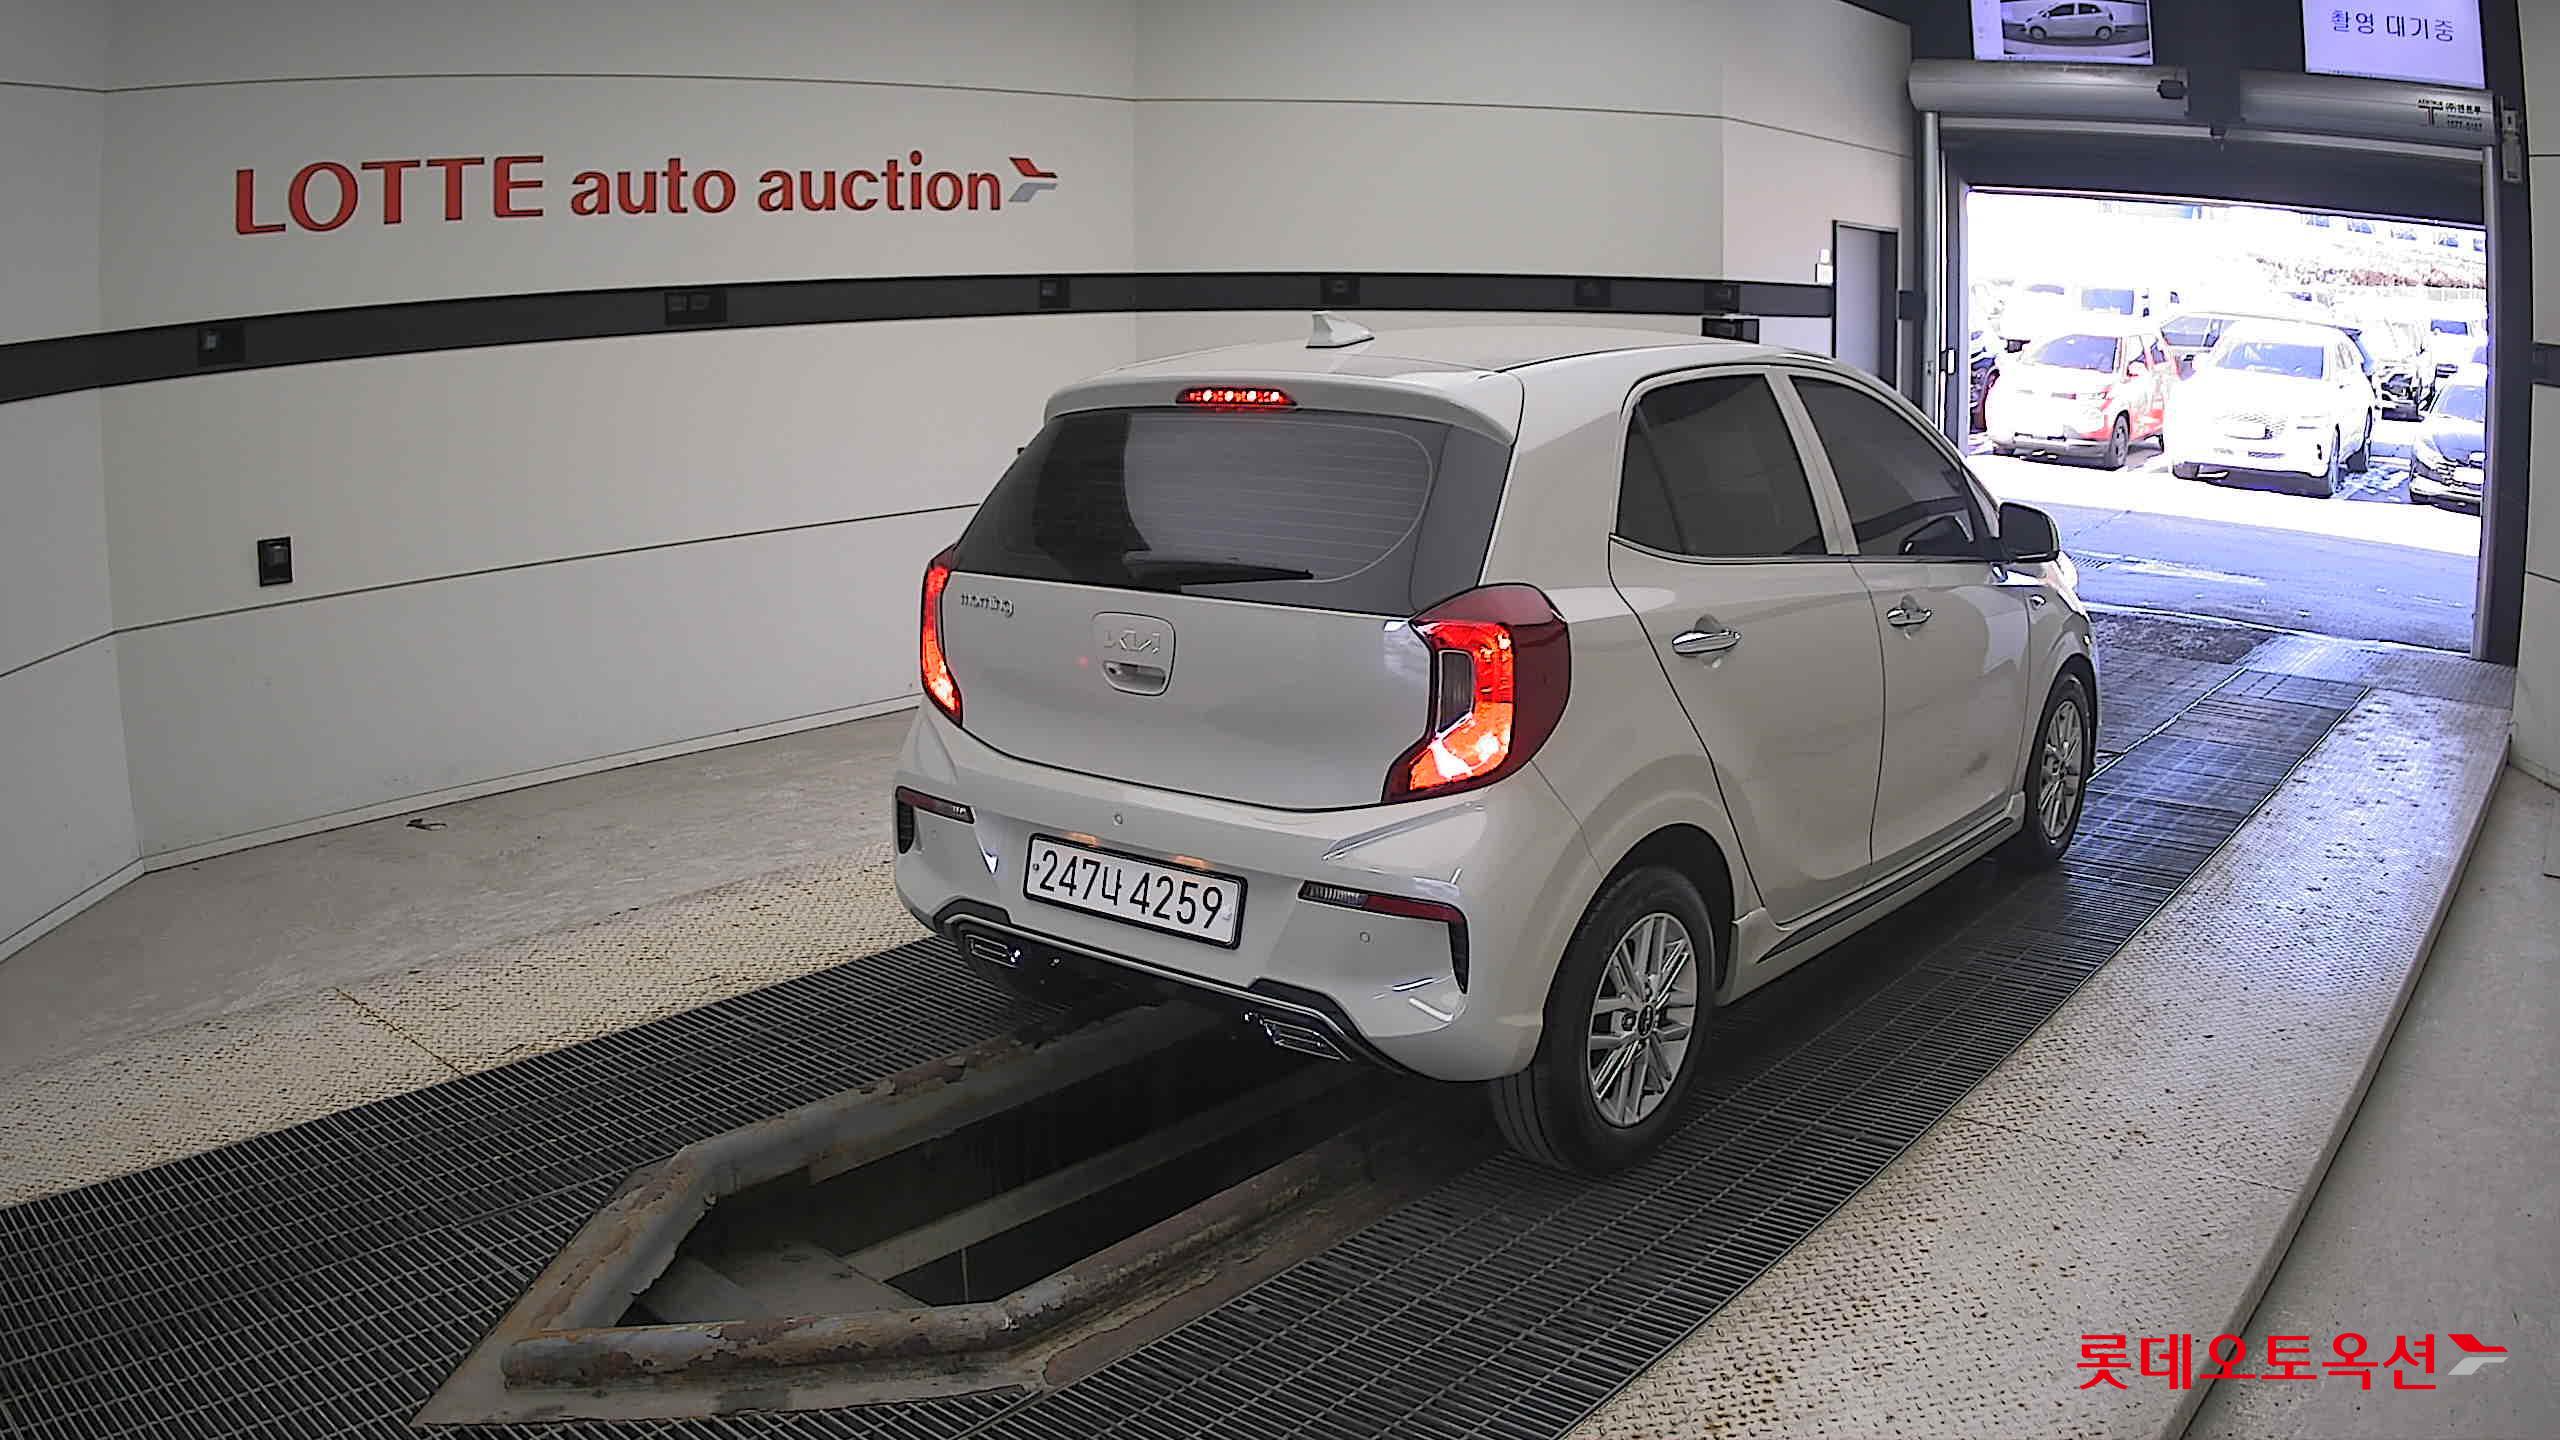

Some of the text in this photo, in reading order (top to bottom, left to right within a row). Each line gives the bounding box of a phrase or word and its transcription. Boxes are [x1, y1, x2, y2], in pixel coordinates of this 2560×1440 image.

[2333, 9, 2454, 42] 촬영 대기중
[236, 152, 1002, 234] LOTTE auto auction
[1039, 849, 1223, 929] 247나 4259
